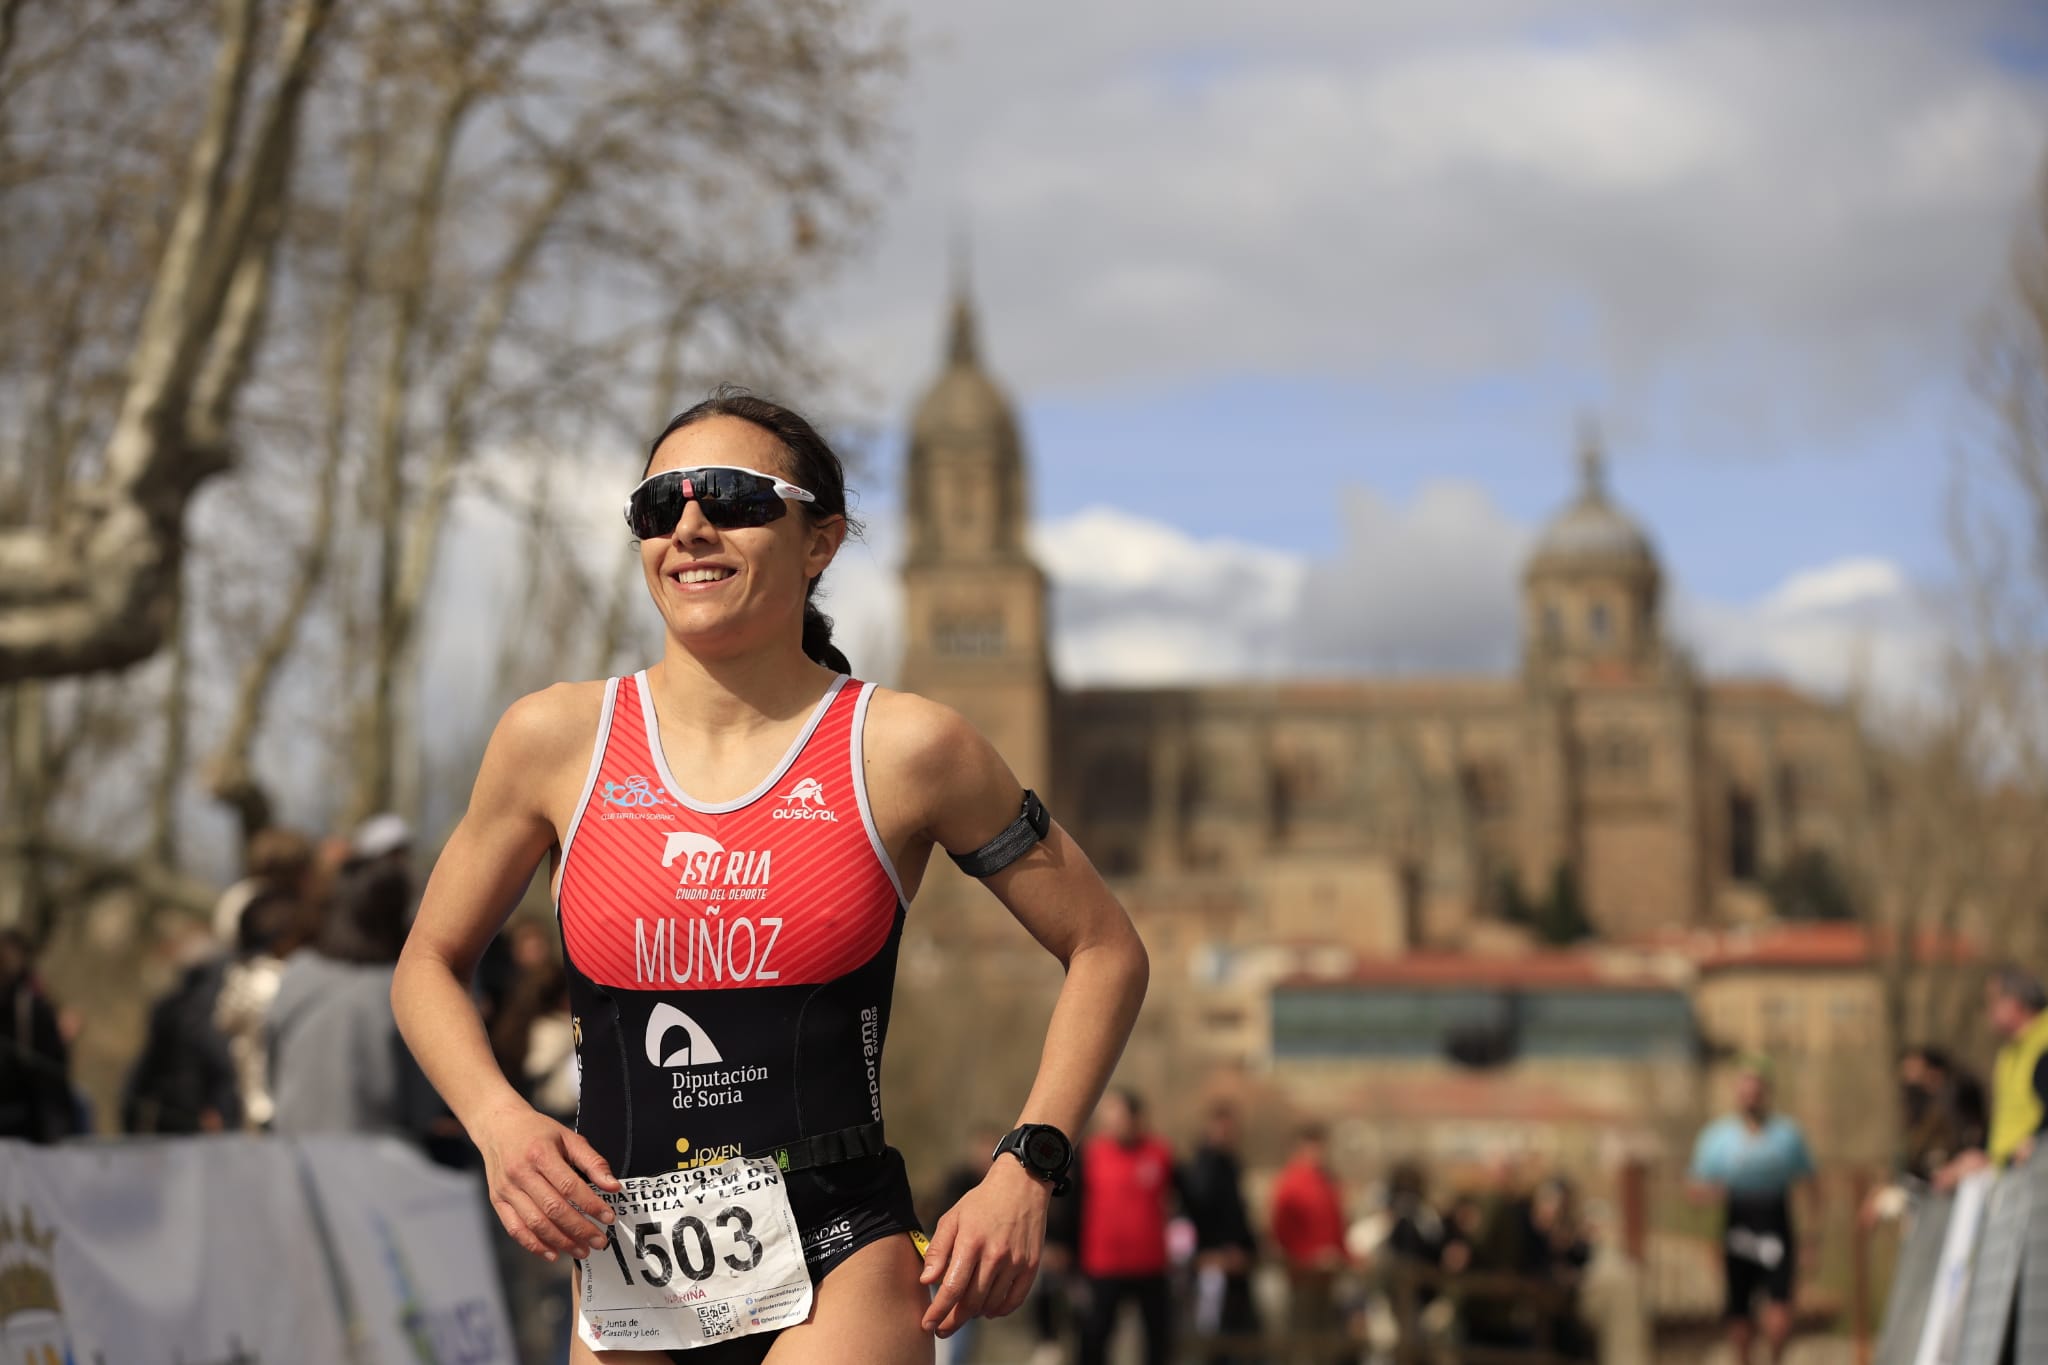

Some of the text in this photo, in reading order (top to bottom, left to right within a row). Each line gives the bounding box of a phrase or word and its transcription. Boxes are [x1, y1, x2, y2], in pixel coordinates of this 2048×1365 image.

[679, 850, 772, 885] SORIA
[675, 888, 768, 900] CIUDAD DEL DEPORTE
[635, 905, 783, 984] MUÑOZ
[861, 1008, 881, 1121] deporama
[672, 1065, 768, 1093] Diputación
[672, 1087, 743, 1109] de Soria
[695, 1142, 742, 1165] JOVEN
[599, 1187, 677, 1203] RIATLON
[747, 1165, 776, 1178] DE
[625, 1167, 723, 1190] ERACION
[611, 1198, 684, 1216] STILLA
[695, 1193, 706, 1204] Y
[719, 1175, 779, 1198] LEON
[603, 1206, 763, 1287] 1503
[603, 1329, 632, 1337] Castilla
[633, 1330, 639, 1338] y
[605, 1319, 639, 1328] Junta de
